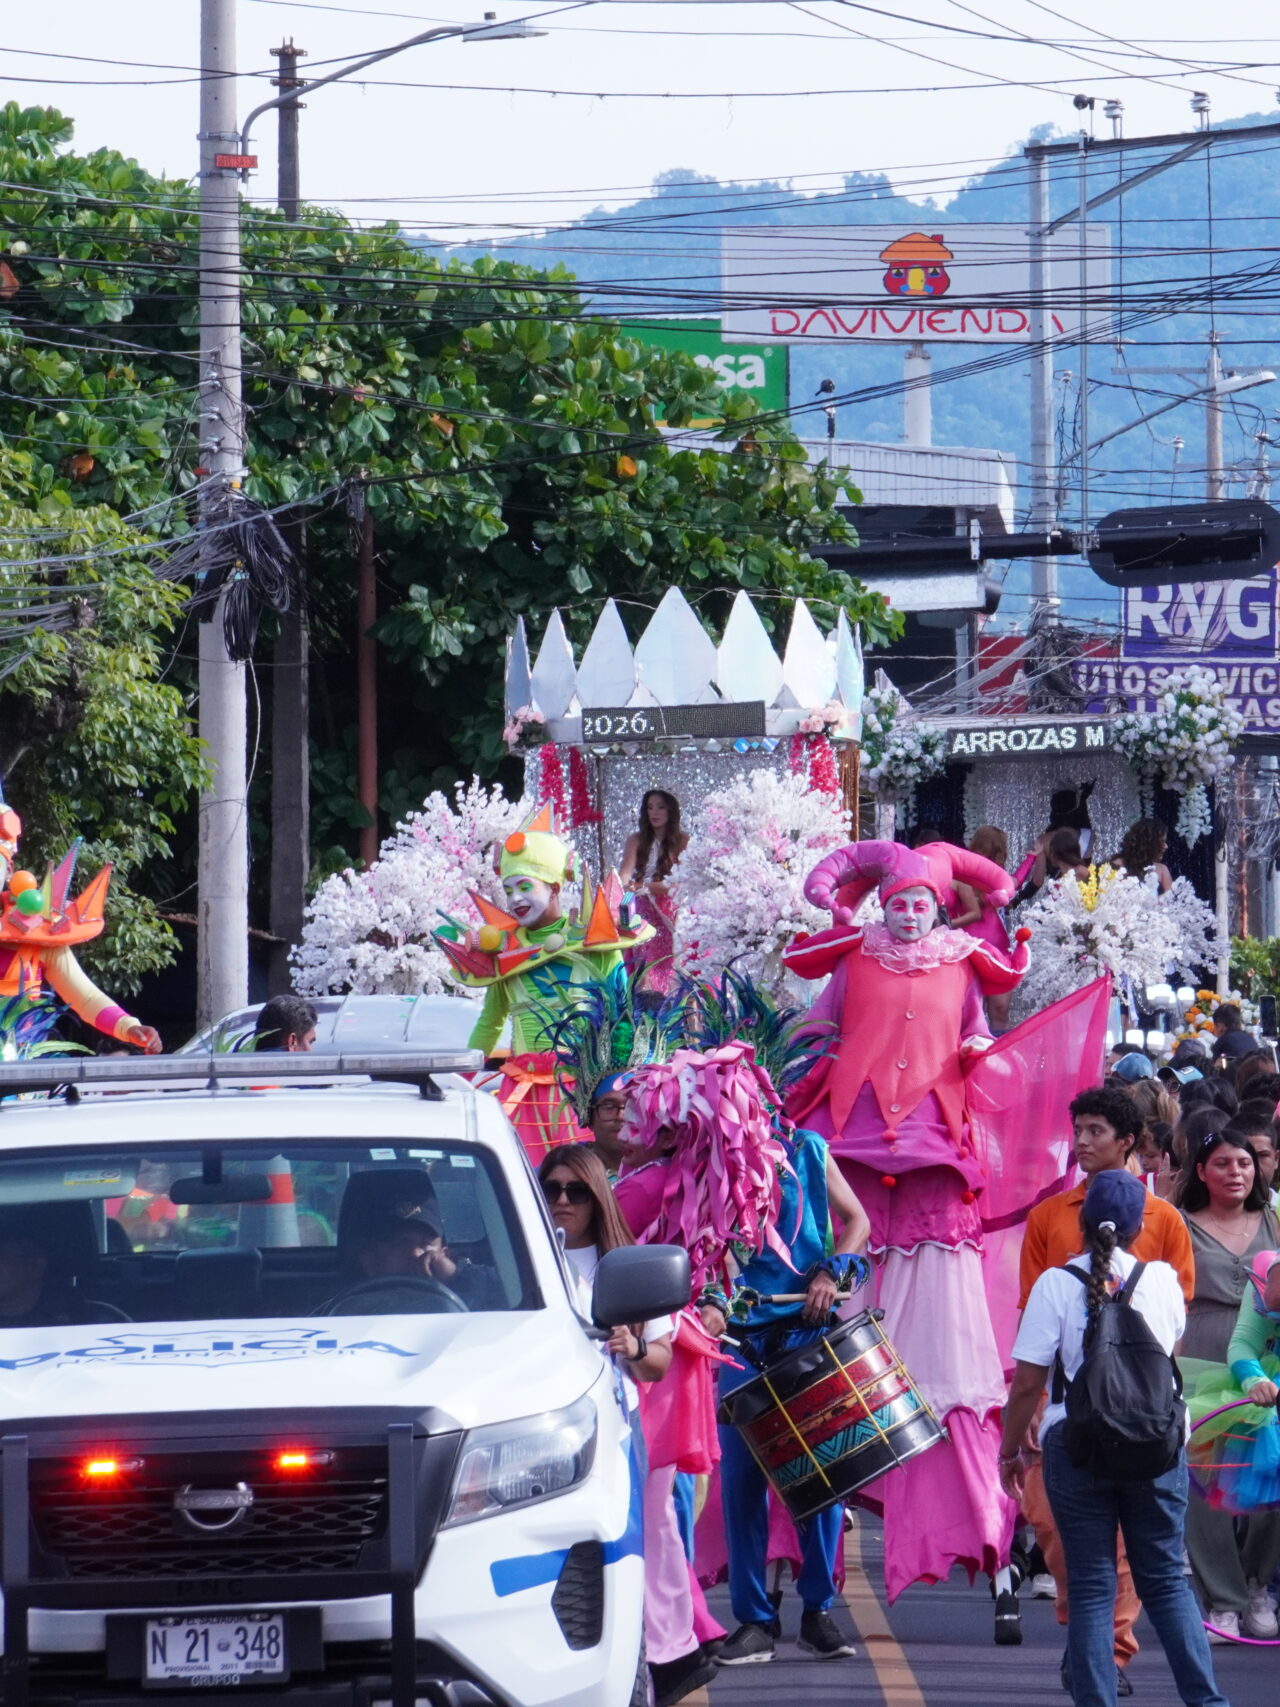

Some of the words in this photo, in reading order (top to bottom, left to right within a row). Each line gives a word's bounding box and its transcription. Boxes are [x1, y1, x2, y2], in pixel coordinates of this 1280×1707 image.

[951, 726, 1077, 754] ARROZAS
[151, 1629, 168, 1665] N
[185, 1627, 211, 1664] 21
[234, 1624, 281, 1661] 348
